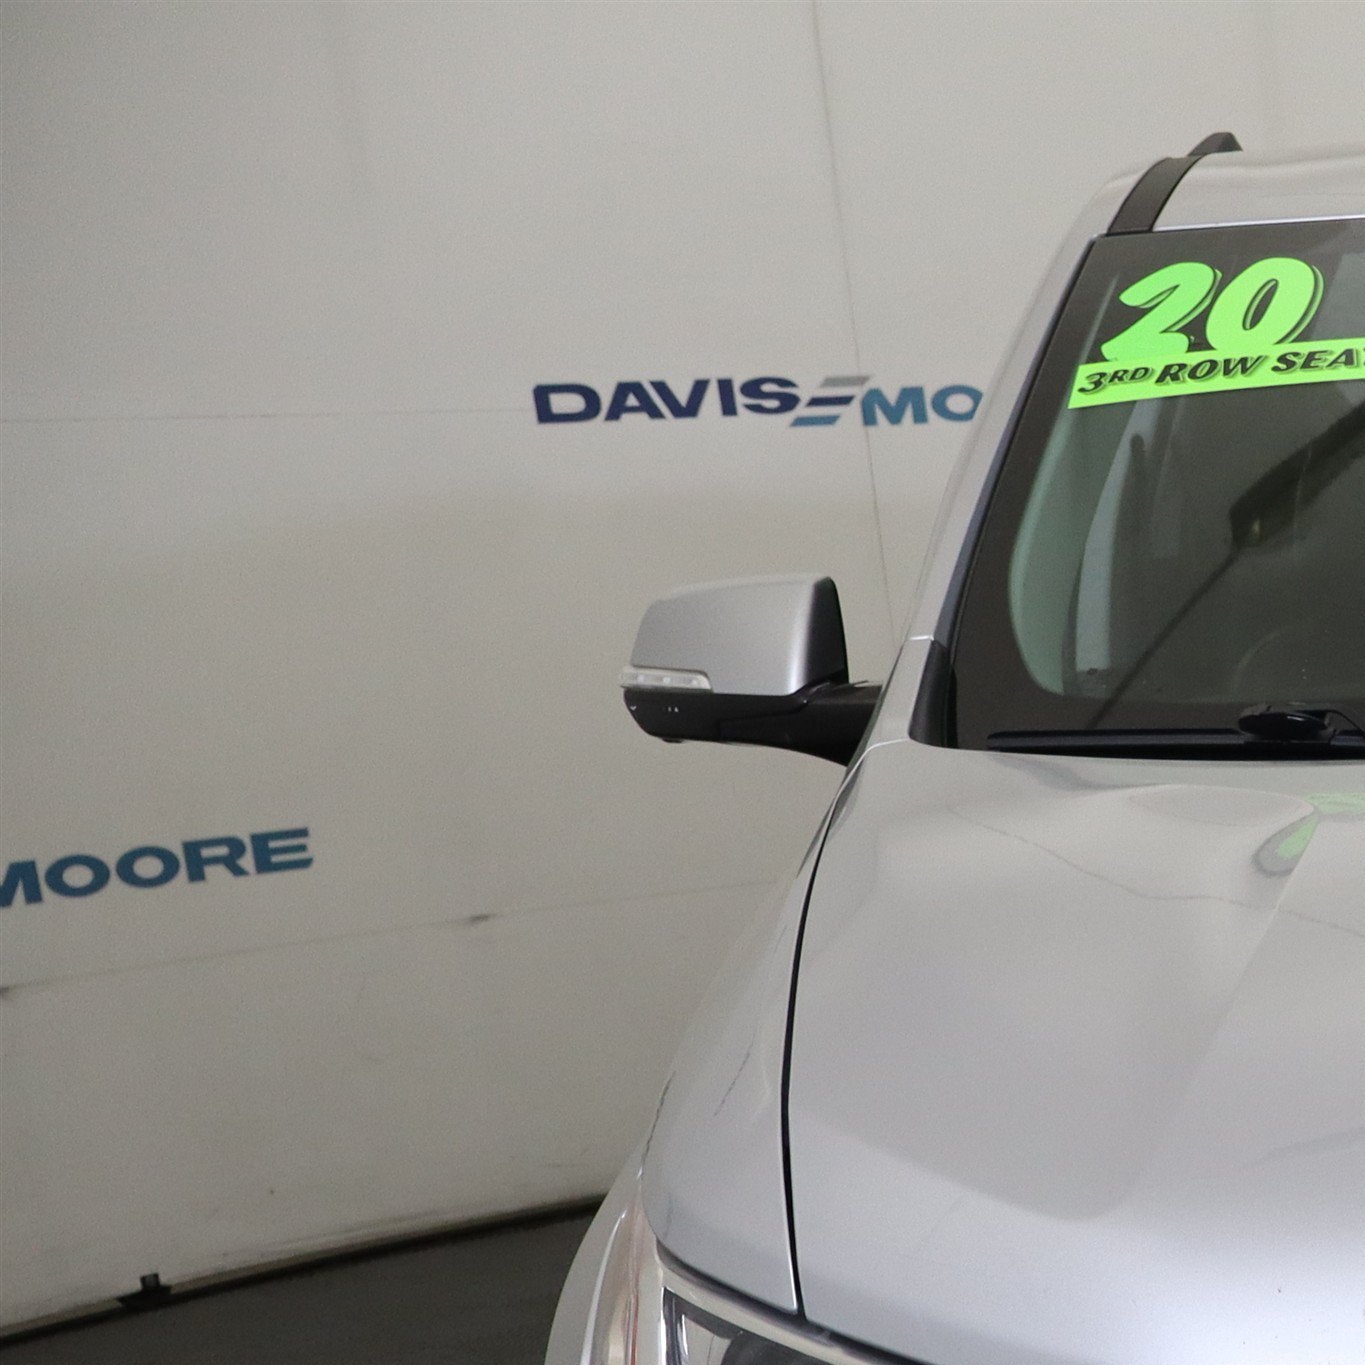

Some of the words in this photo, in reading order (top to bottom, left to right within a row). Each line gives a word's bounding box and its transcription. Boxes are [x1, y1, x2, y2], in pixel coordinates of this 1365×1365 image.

[1101, 257, 1325, 361] 20
[533, 376, 802, 424] DAVIS
[1078, 366, 1153, 396] 3RD
[1156, 353, 1266, 387] ROW
[0, 827, 314, 908] MOORE
